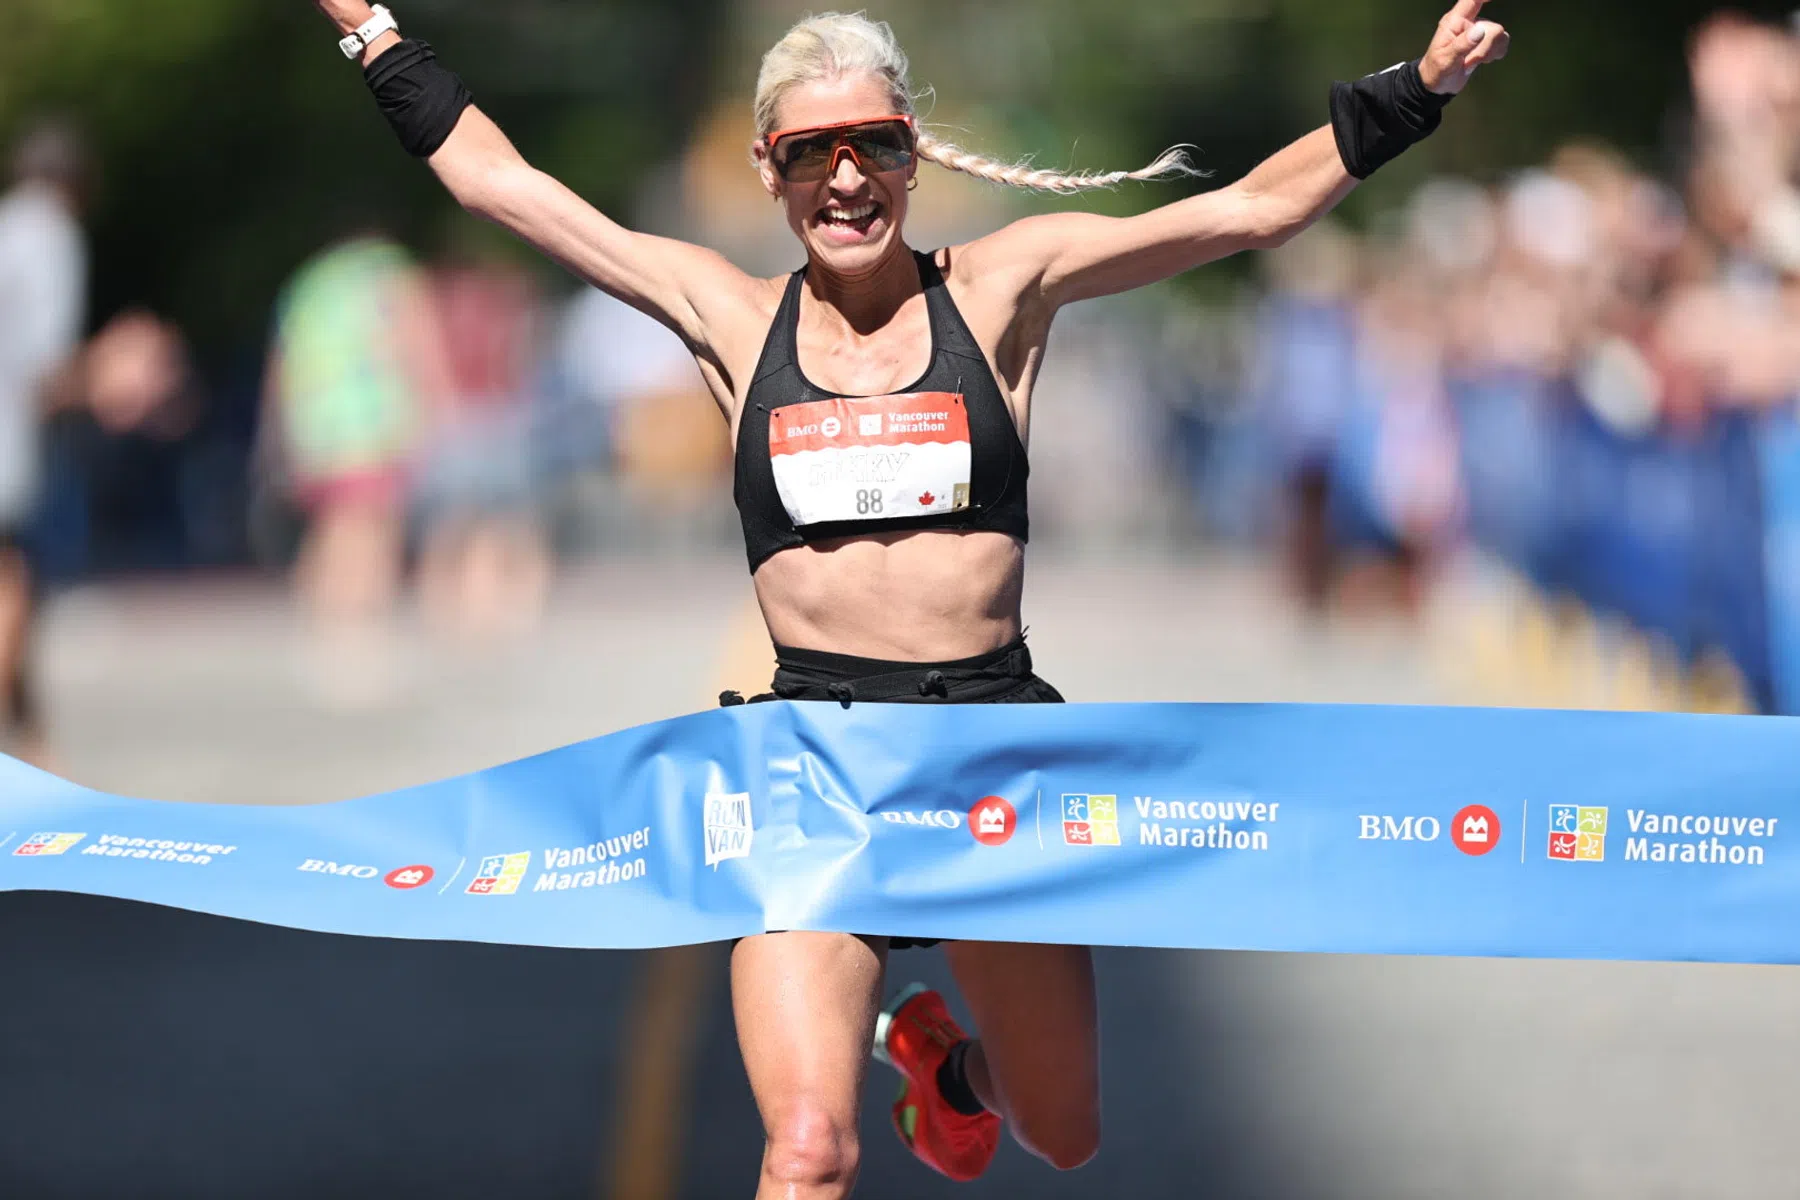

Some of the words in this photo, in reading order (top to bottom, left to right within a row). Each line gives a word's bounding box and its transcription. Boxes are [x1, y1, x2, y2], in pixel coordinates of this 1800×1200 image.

[889, 411, 949, 422] Vancouver
[889, 421, 945, 432] Marathon
[787, 424, 818, 438] BMO
[856, 488, 883, 514] 88
[708, 799, 746, 827] RUN
[1134, 796, 1279, 822] Vancouver
[1358, 815, 1439, 841] BMO
[1627, 810, 1778, 836] Vancouver
[99, 834, 238, 855] Vancouver
[544, 826, 650, 870] Vancouver
[708, 828, 745, 854] VAN
[1140, 823, 1268, 850] Marathon
[81, 843, 212, 865] Marathon
[1625, 838, 1764, 864] Marathon
[297, 859, 379, 879] BMO
[533, 857, 646, 892] Marathon
